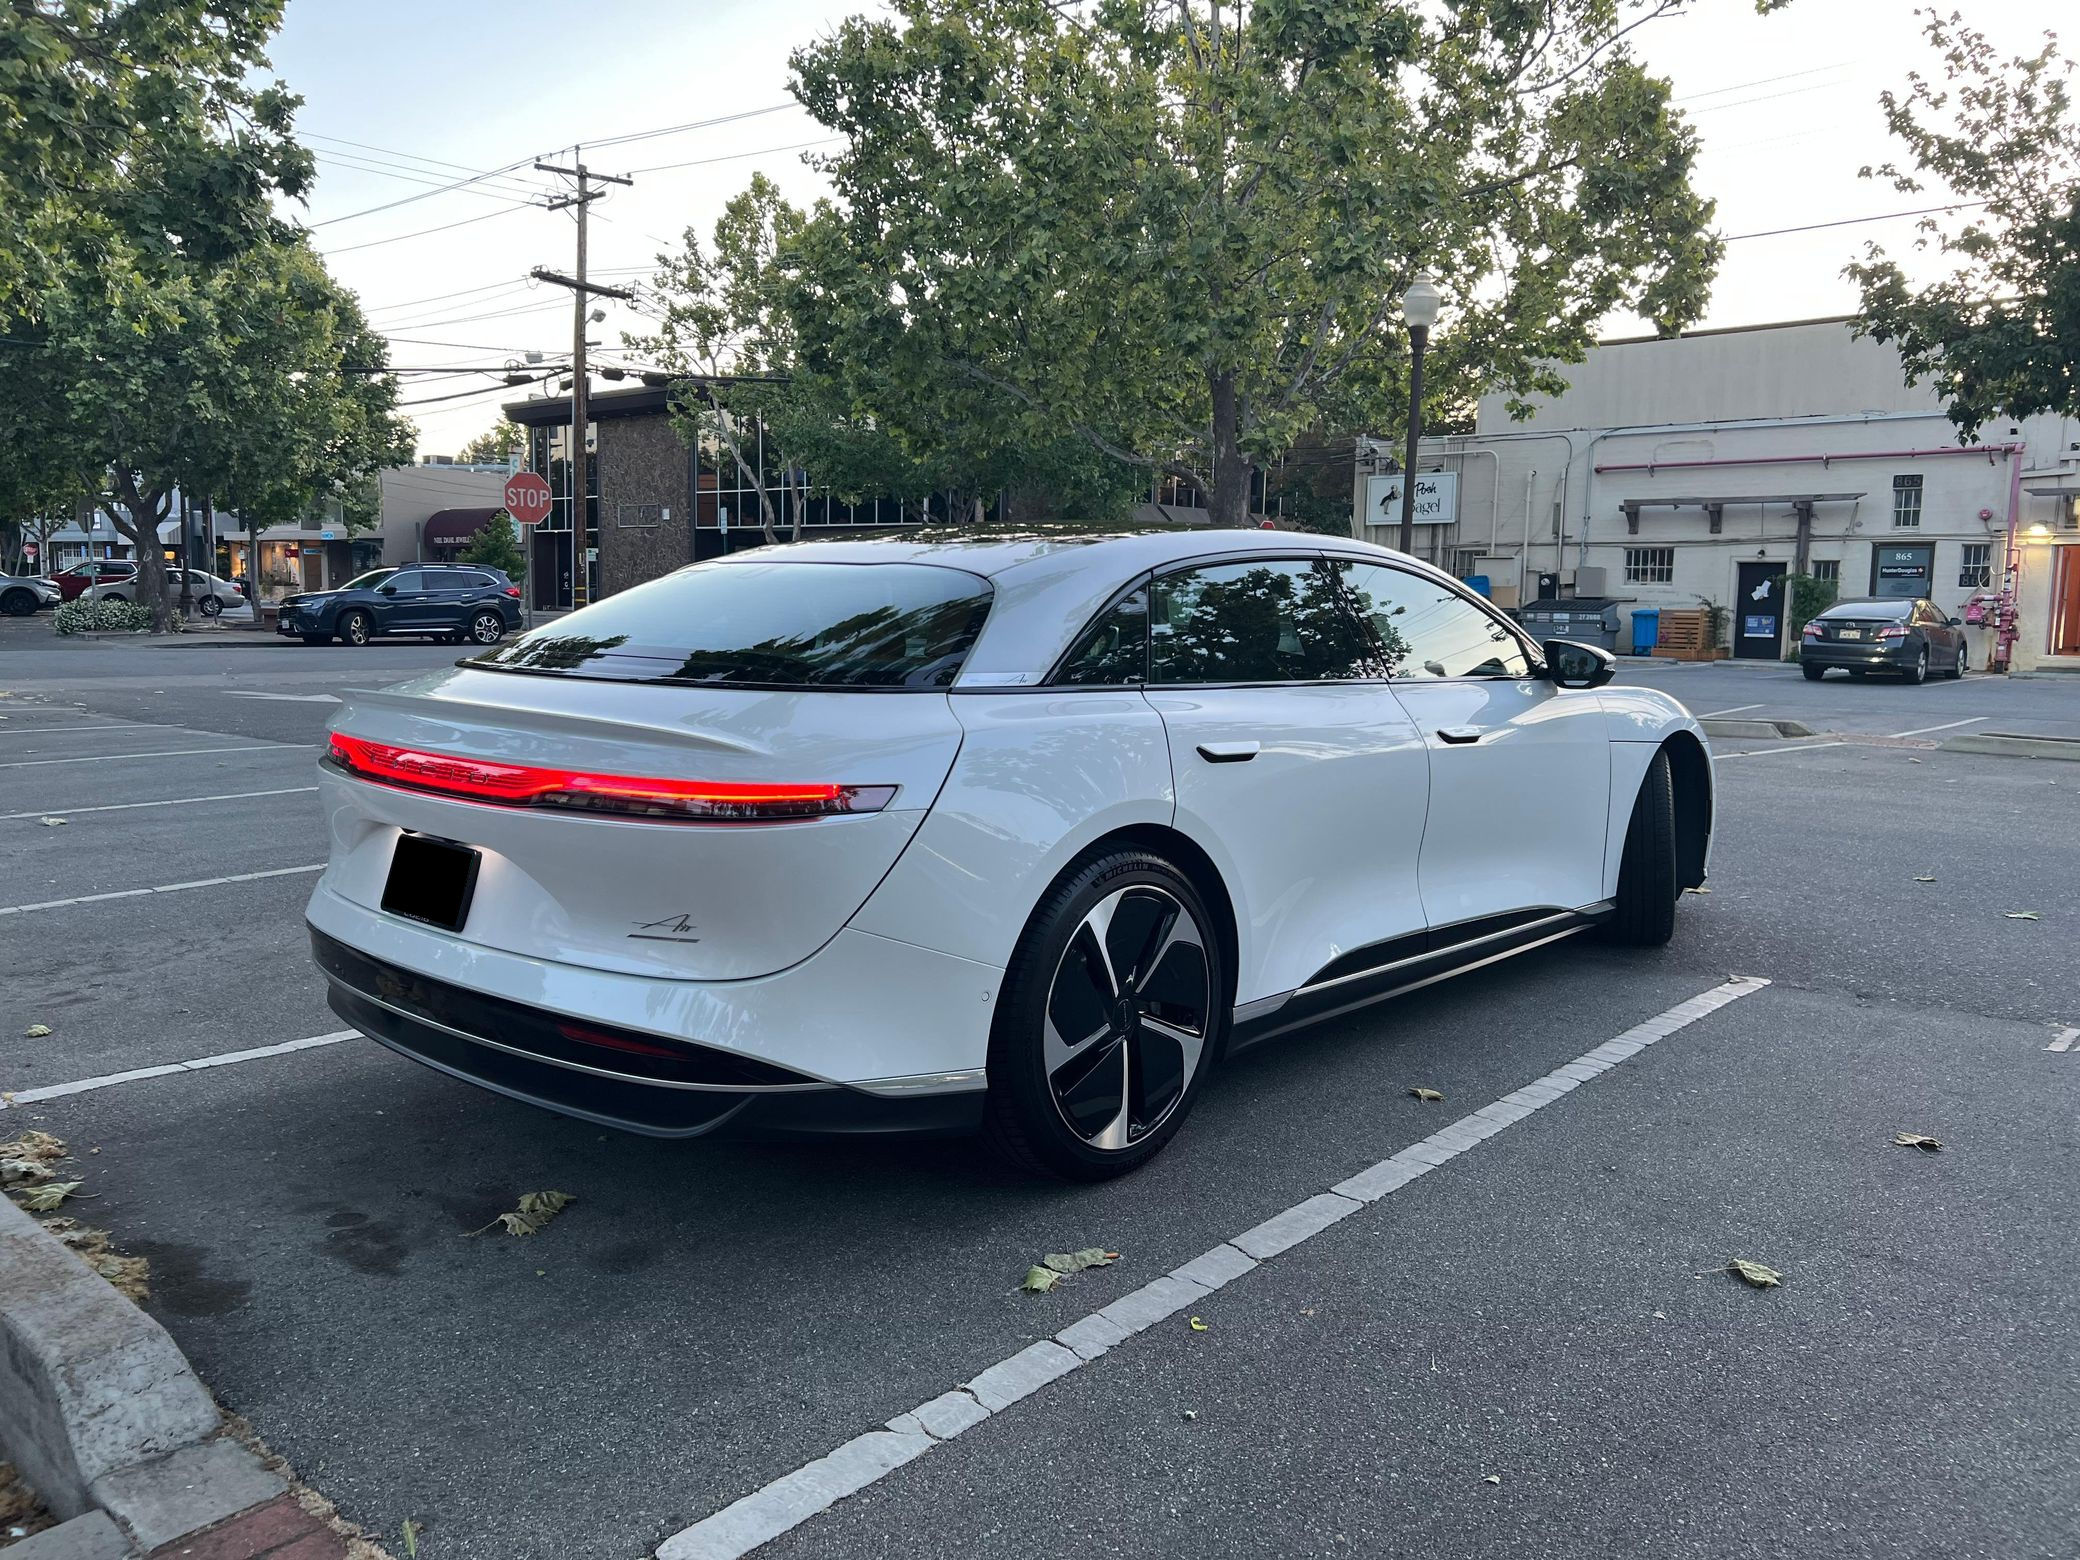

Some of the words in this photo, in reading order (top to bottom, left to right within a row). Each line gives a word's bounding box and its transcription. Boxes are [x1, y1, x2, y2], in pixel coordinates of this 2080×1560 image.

[507, 487, 549, 508] STOP
[1414, 482, 1437, 497] Posh
[1895, 552, 1913, 561] 865
[1104, 863, 1149, 882] MICHELIN
